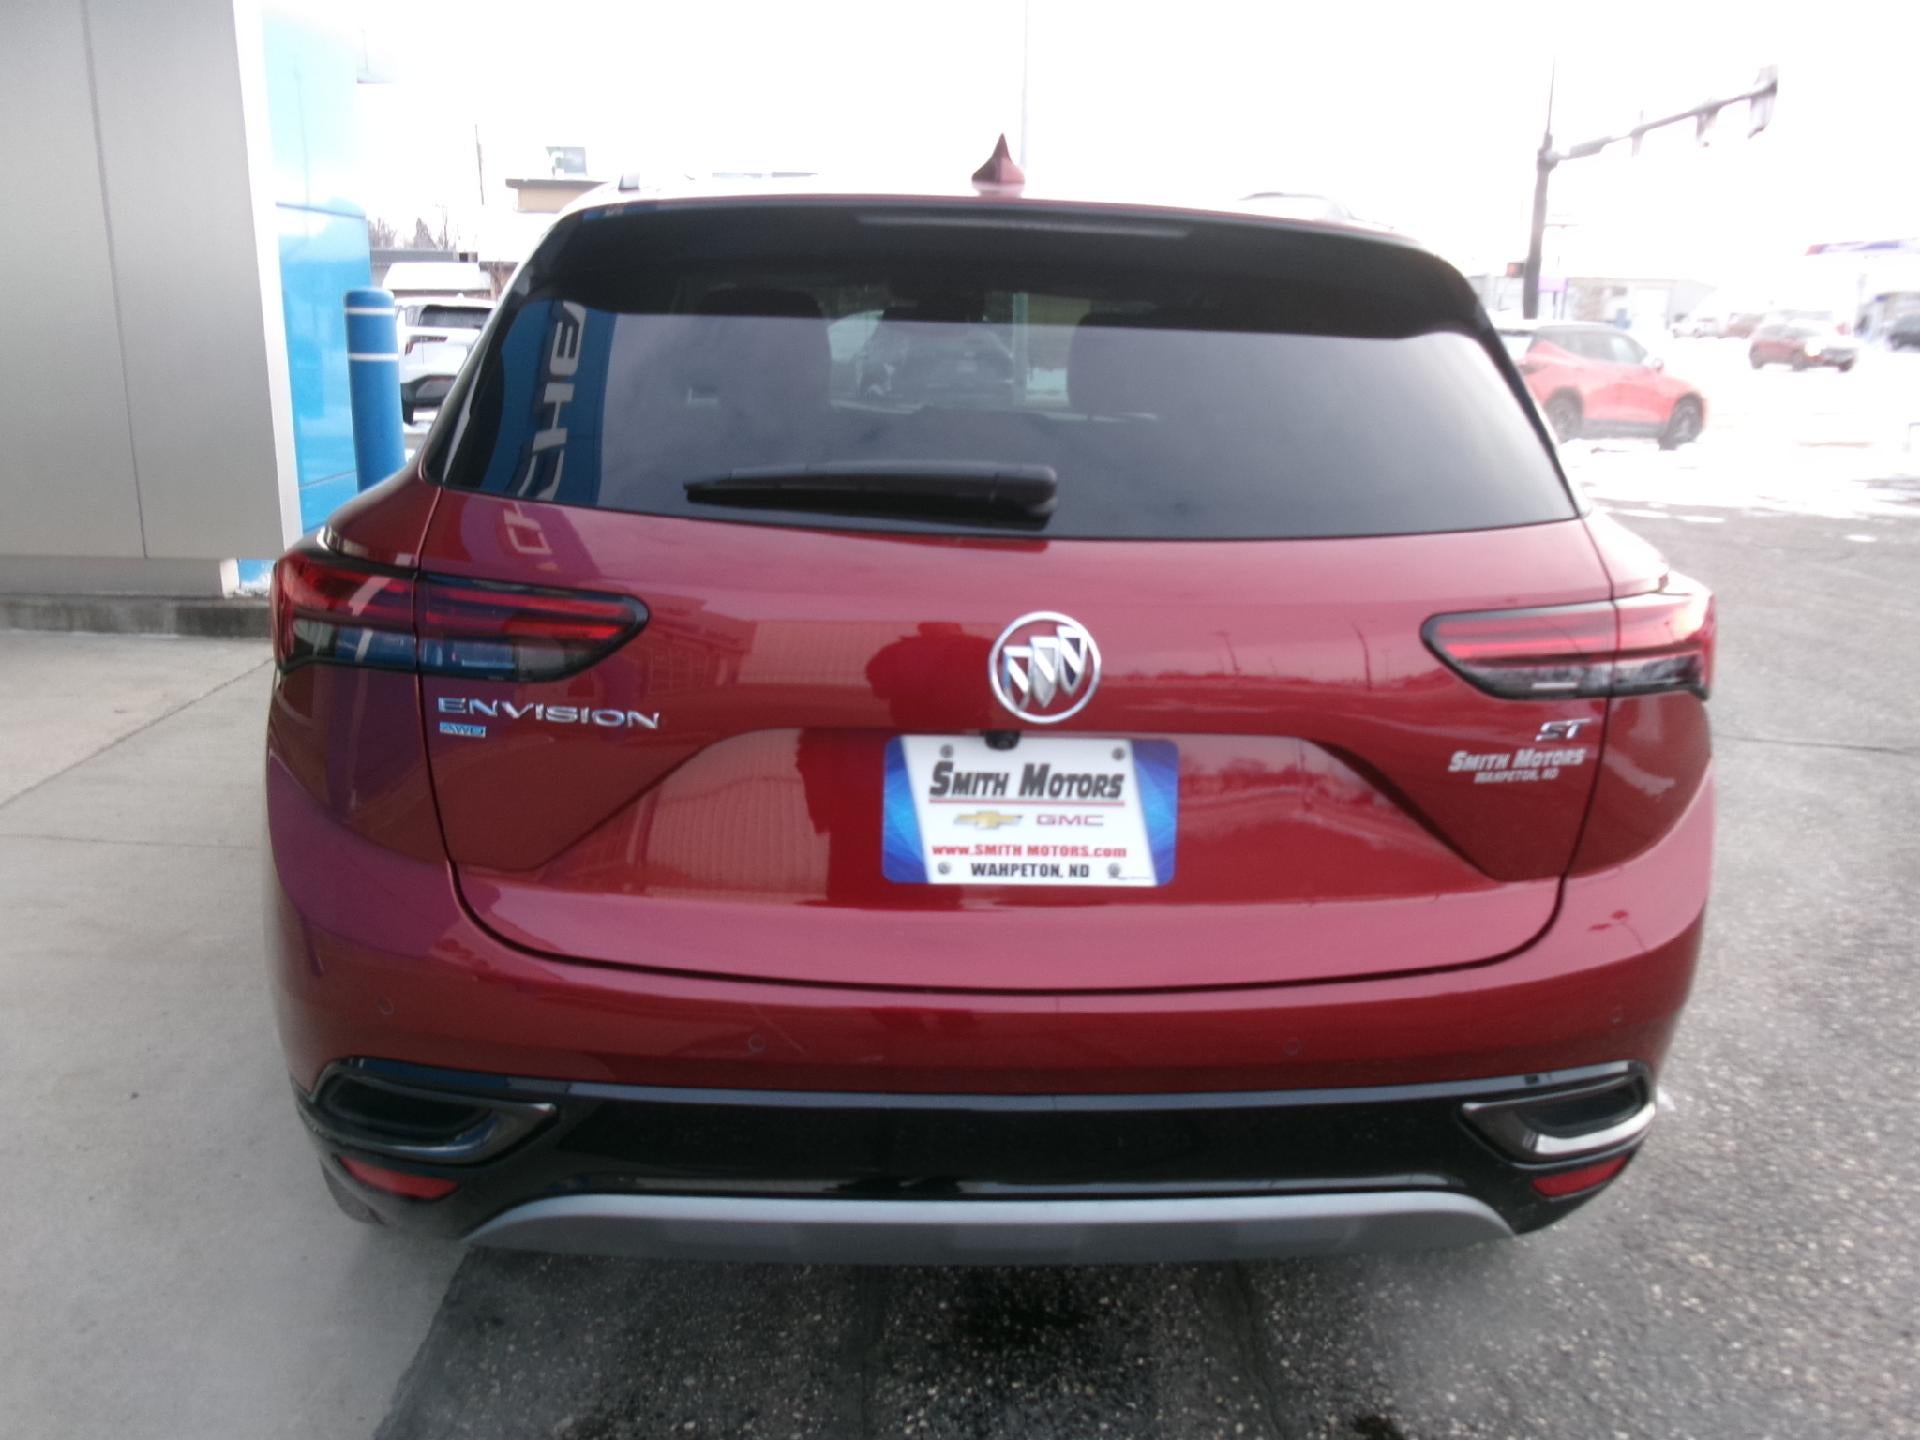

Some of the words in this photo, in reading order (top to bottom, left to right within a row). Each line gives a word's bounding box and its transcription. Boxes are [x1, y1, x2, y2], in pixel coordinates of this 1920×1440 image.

[438, 697, 660, 729] ENVISION
[1535, 718, 1592, 742] ST
[1448, 750, 1510, 772] SMITH
[1512, 748, 1586, 768] MOTORS
[929, 761, 1009, 796] SMITH
[1018, 764, 1125, 798] MOTORS
[1036, 815, 1104, 826] GMC
[970, 863, 1063, 878] WAHPETON,
[1069, 865, 1090, 878] ND
